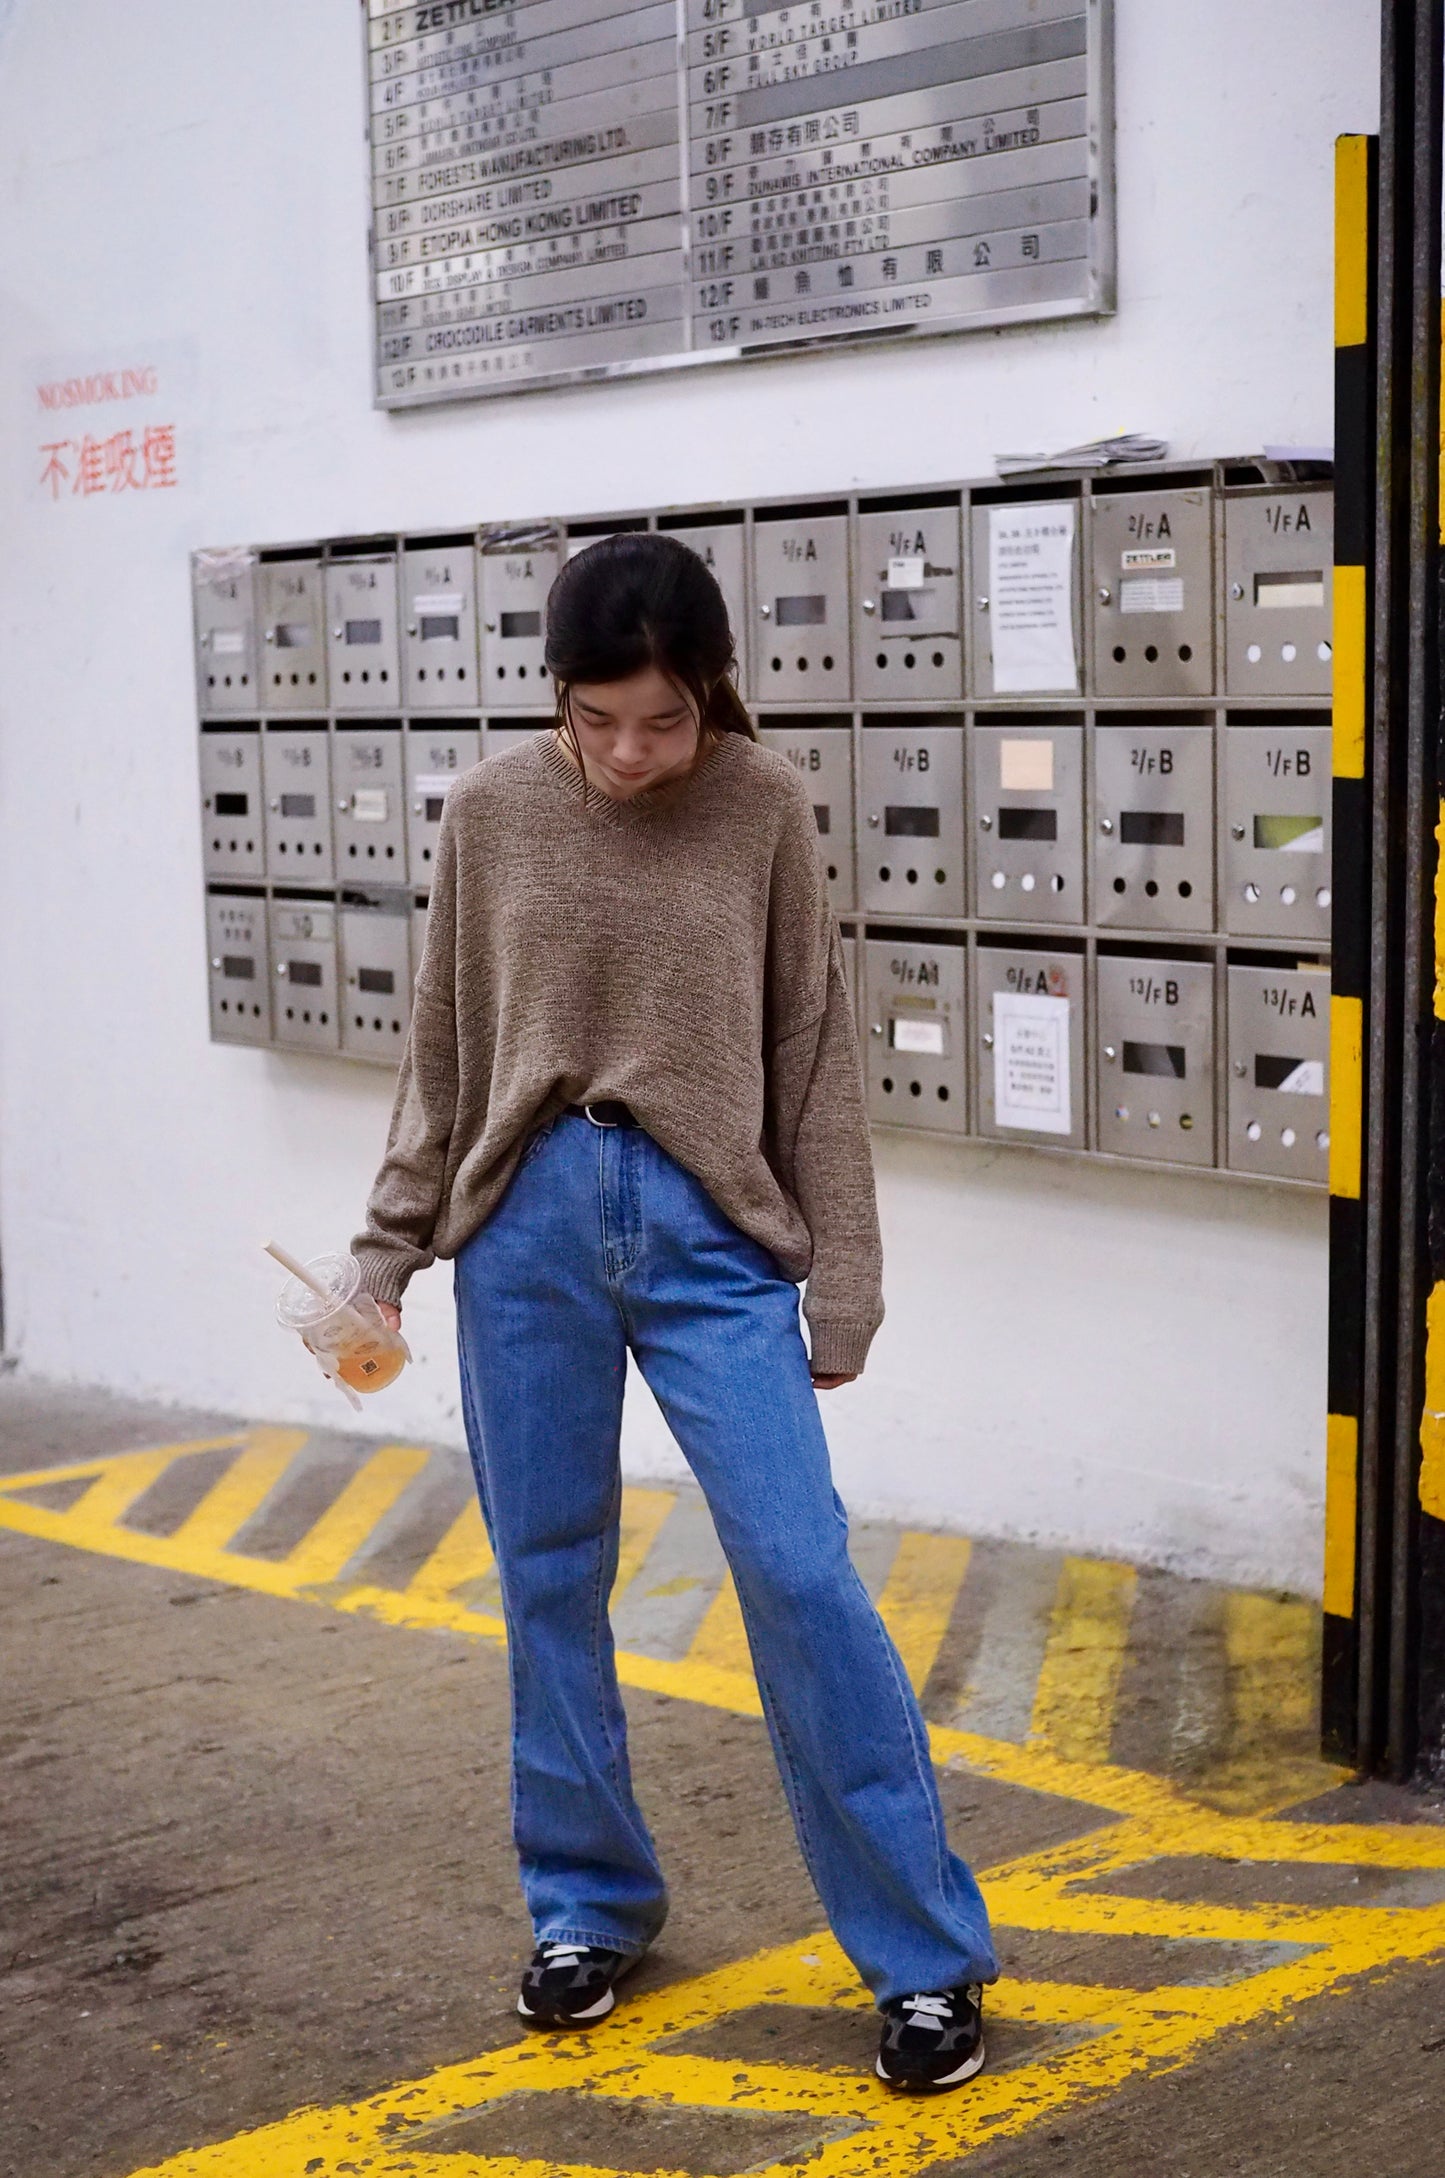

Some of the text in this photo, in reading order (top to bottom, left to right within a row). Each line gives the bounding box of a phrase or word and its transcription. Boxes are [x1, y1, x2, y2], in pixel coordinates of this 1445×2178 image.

[416, 0, 516, 31] ZETTL
[800, 12, 855, 40] TARGET
[479, 134, 596, 177] MANUFACTURING
[806, 150, 905, 184] INTERNATIONAL
[911, 138, 978, 165] COMPANY
[984, 127, 1041, 151] LIMITED
[497, 179, 552, 208] LIMITED
[475, 217, 523, 245] HONG
[524, 207, 573, 235] KONG
[575, 192, 642, 226] LIMITED
[426, 321, 504, 352] CROCODILE
[508, 307, 584, 339] GARMENTS
[585, 297, 648, 327] LIMITED
[797, 300, 879, 325] ELECTRONICS
[882, 293, 932, 313] LIMITED
[1126, 554, 1171, 564] ZETTLER
